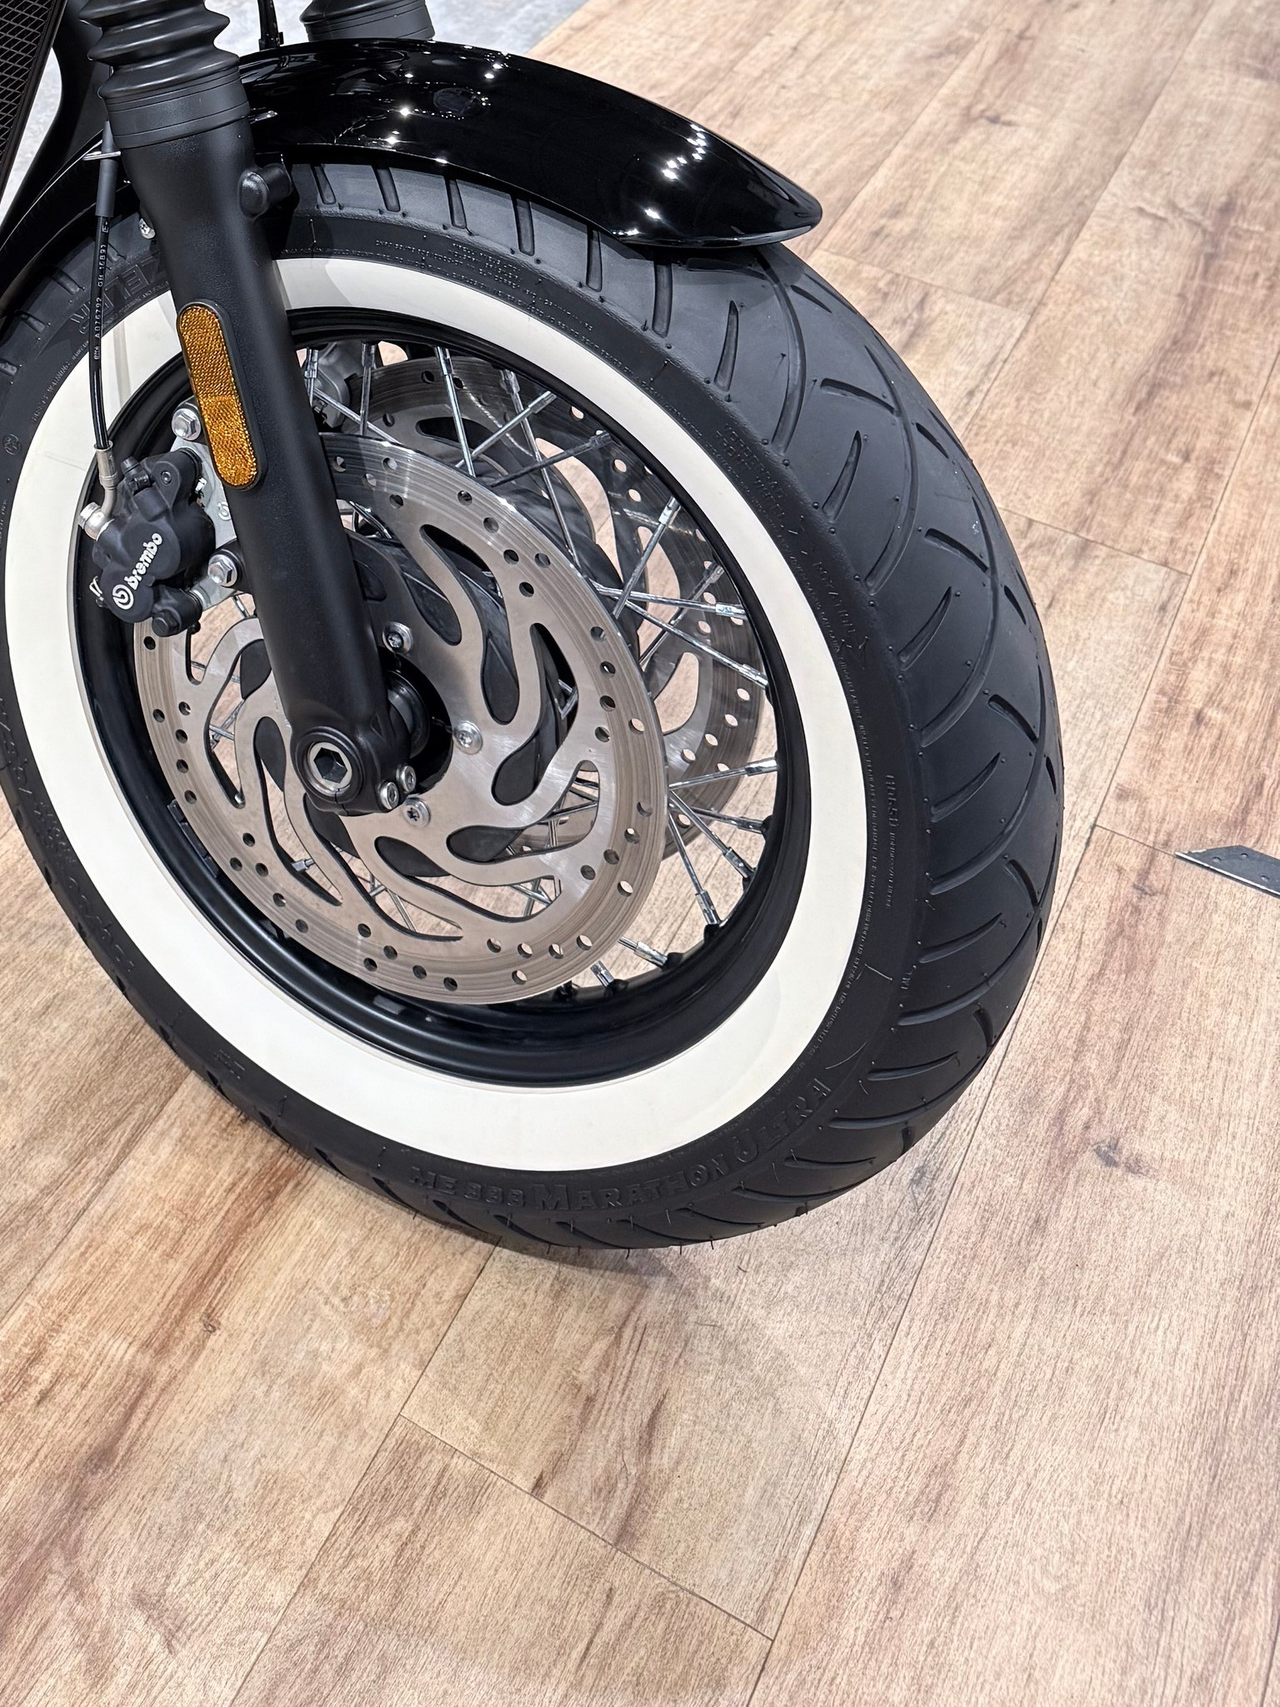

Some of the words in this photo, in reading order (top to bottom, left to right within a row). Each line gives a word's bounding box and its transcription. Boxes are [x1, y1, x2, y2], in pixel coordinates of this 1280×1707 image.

[124, 532, 163, 592] brembo
[407, 1164, 460, 1196] ME
[532, 1153, 730, 1211] MARATHON
[731, 1077, 833, 1165] ULTRA
